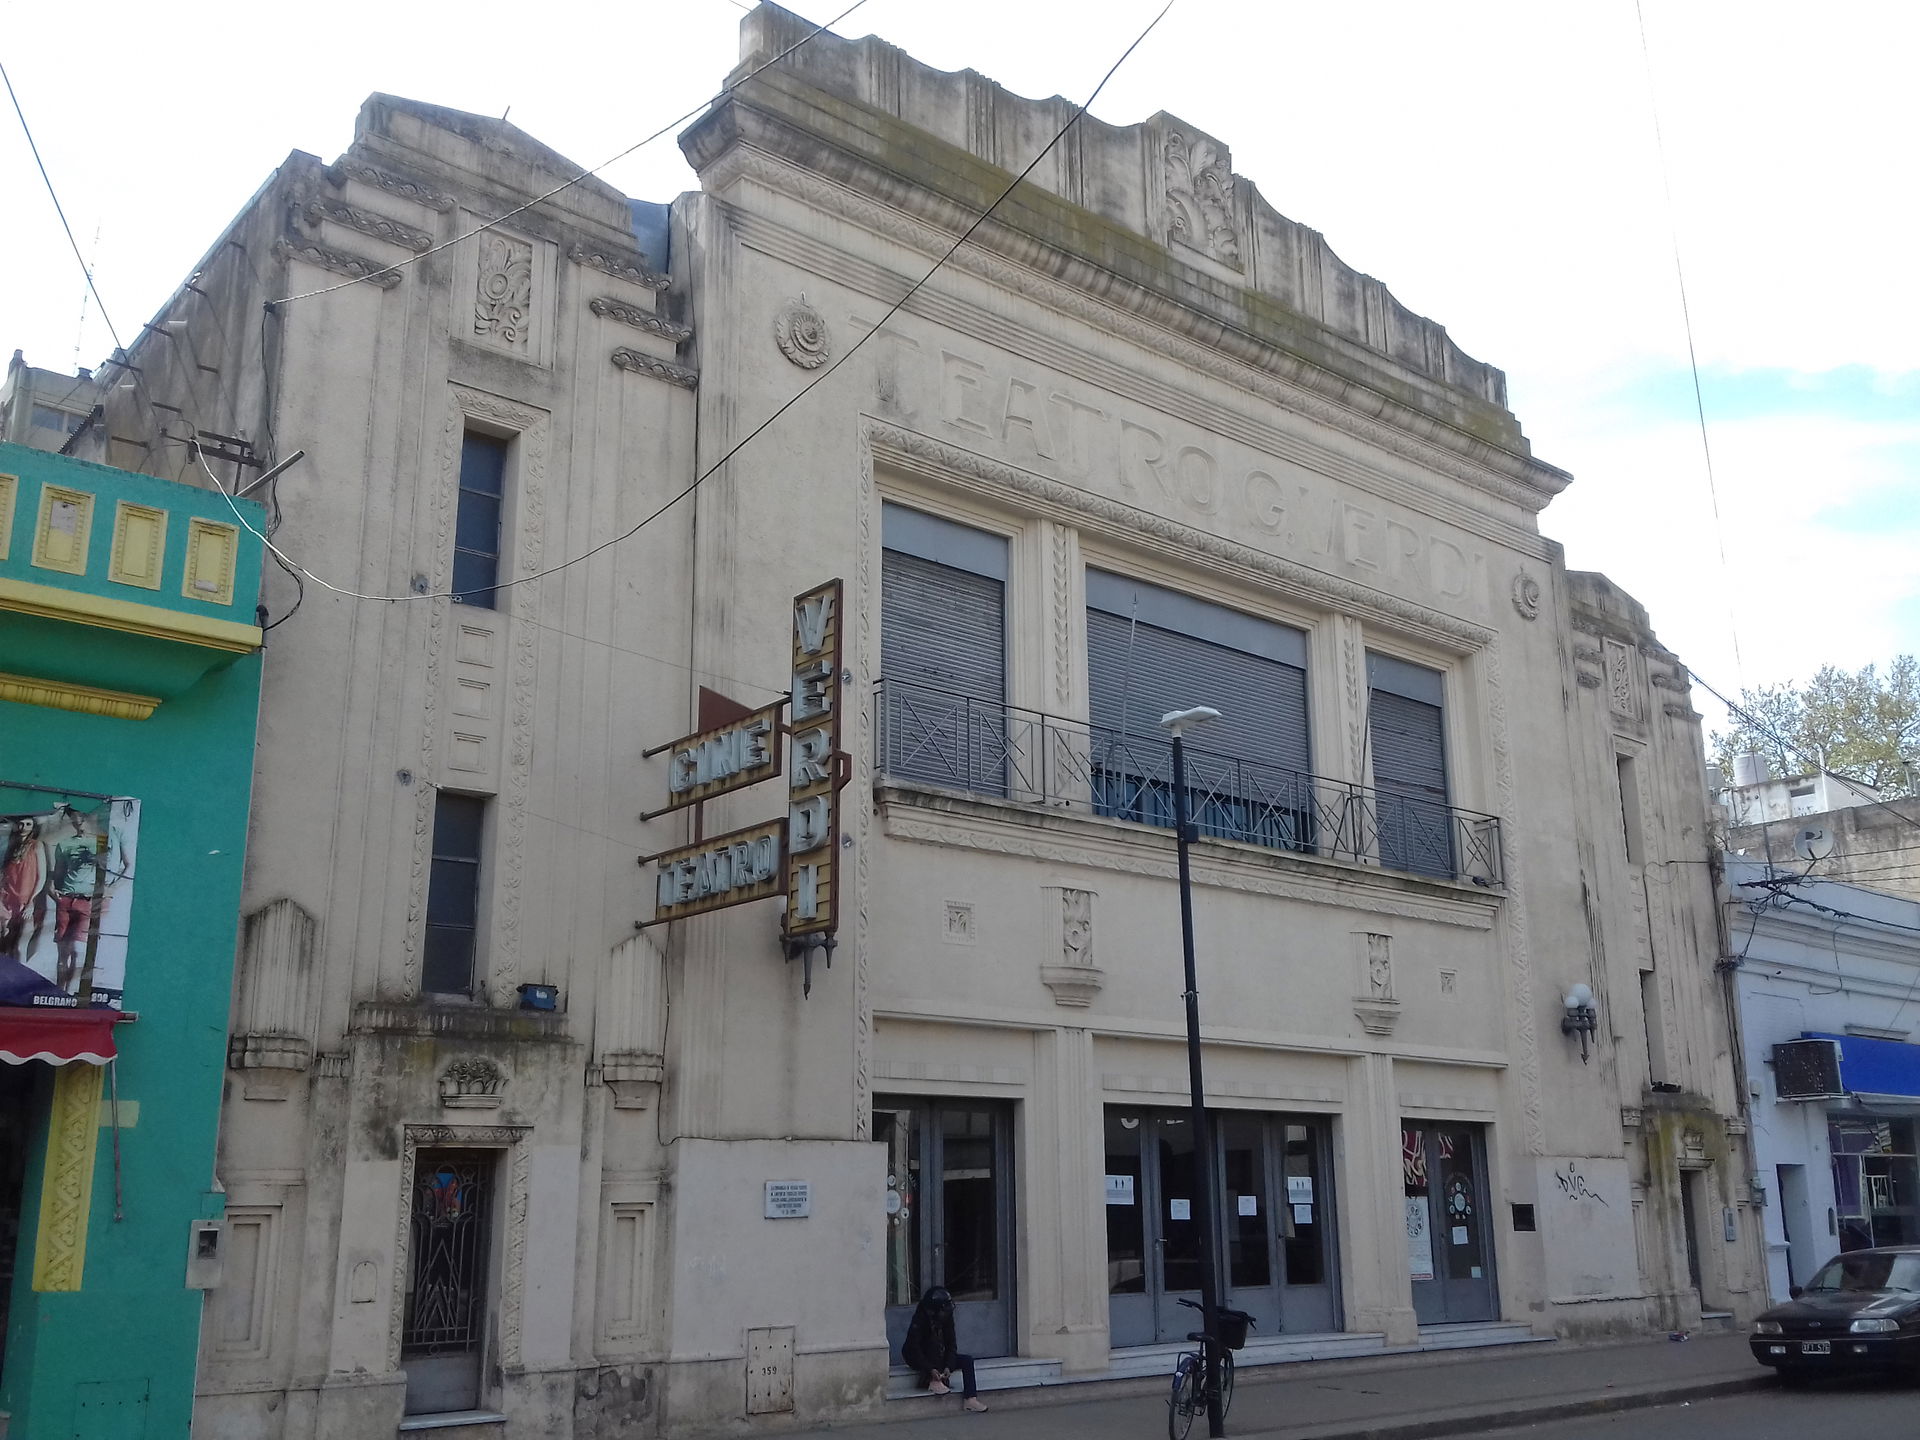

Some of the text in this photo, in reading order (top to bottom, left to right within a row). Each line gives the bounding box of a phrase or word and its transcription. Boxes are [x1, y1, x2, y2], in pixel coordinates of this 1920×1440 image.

[848, 314, 1221, 514] TEATRO
[1297, 484, 1489, 616] VERDI
[669, 718, 771, 793] CINE
[789, 594, 833, 921] VERDI
[657, 833, 780, 908] TEATRO
[33, 995, 78, 1008] BELGRANO
